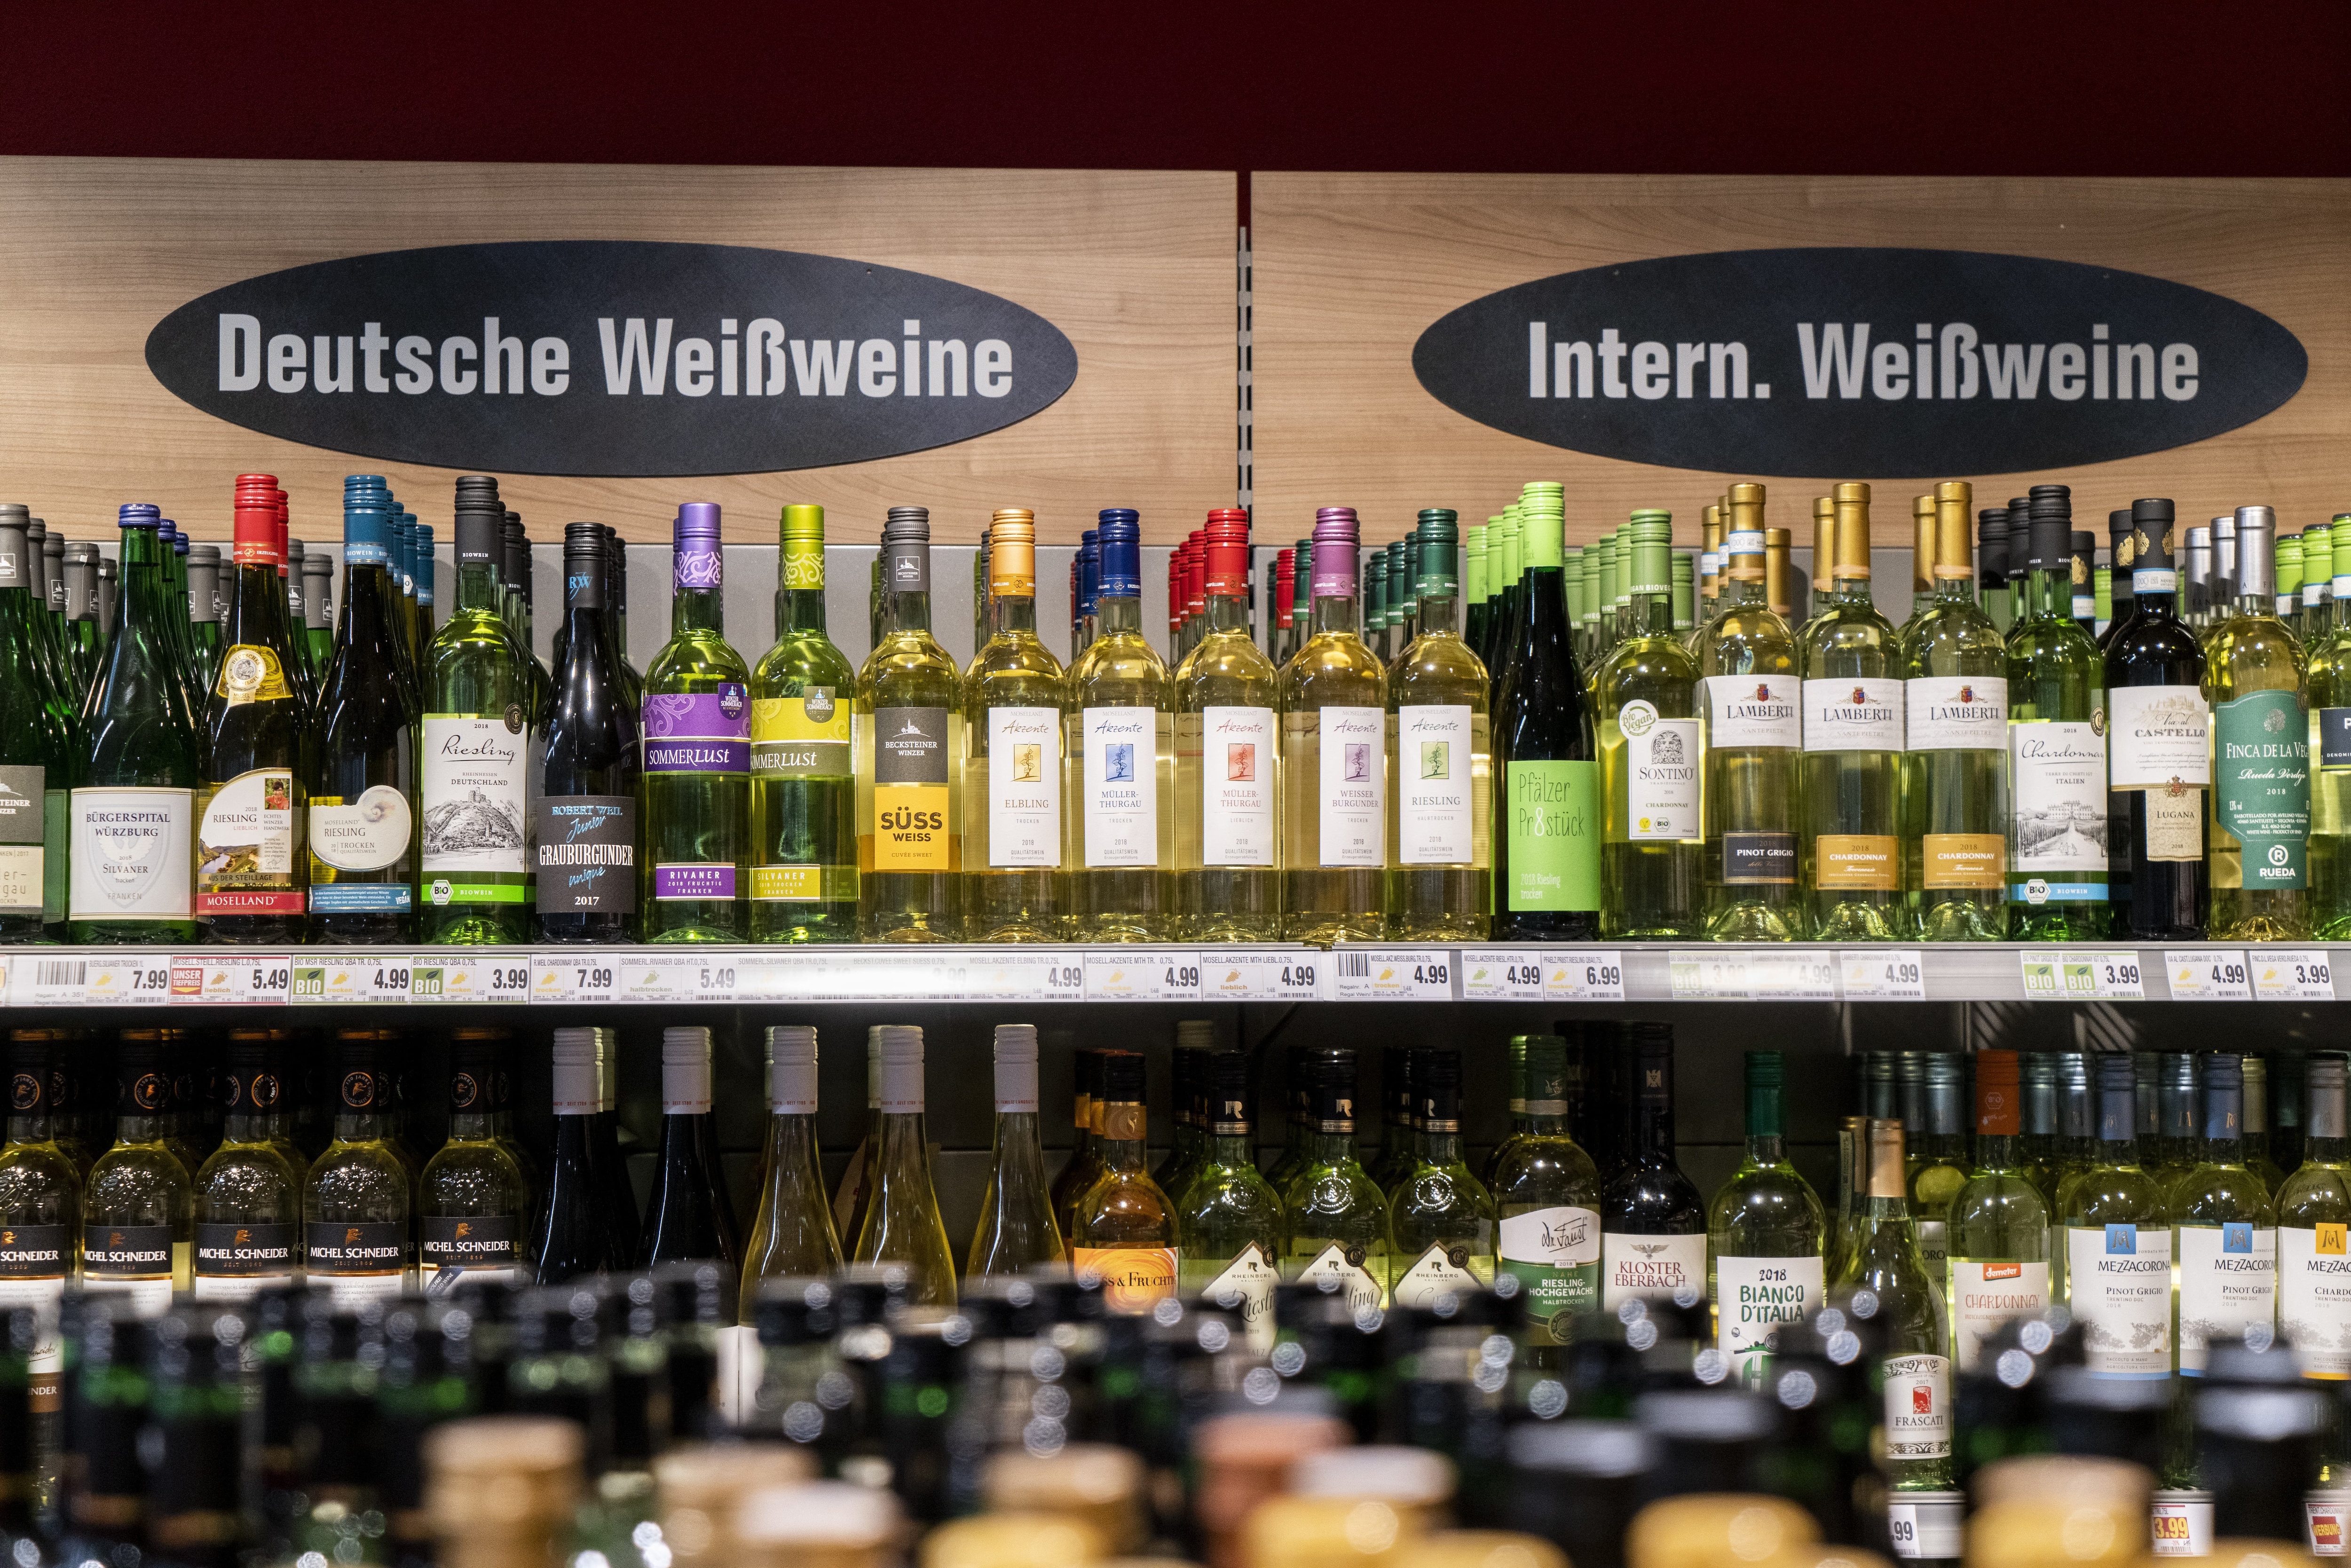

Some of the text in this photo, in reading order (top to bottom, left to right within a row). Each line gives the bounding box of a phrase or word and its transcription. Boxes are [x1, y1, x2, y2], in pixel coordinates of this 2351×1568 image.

[219, 313, 1014, 398] Deutsche Weißweine
[1529, 321, 2200, 402] Intern. Weißweine
[232, 654, 260, 665] DEUTSCHES
[1622, 711, 1636, 723] Bio
[1823, 708, 1892, 721] LAMBERTI
[2155, 713, 2188, 726] Via al
[1002, 719, 1050, 734] Akzente
[1411, 717, 1459, 732] Akzente
[1625, 713, 1656, 731] Vegan
[2135, 729, 2205, 737] CASTELLO
[441, 735, 516, 765] Riesling
[2022, 740, 2104, 767] Chardonnay
[2226, 742, 2291, 758] FINCA DE LA
[1640, 767, 1693, 780] SONTINO
[2238, 768, 2306, 787] Rueda Verdejo
[1101, 790, 1139, 798] MÜLLER-
[1519, 772, 1570, 803] Pfälzer
[1005, 799, 1049, 808] ELBLING
[1412, 796, 1460, 805] RIESLING
[552, 806, 623, 815] ROBERT WEIL
[87, 812, 170, 823] BÜRGERSPITAL
[213, 814, 257, 823] RIESLING
[881, 807, 943, 830] SÜSS
[1519, 807, 1585, 837] Pr8stück
[95, 827, 158, 836] WÜRZBURG
[324, 828, 365, 836] RIESLING
[566, 816, 607, 843] Junior
[892, 833, 931, 842] WEISS
[540, 844, 633, 866] GRAUBURGUNDER
[103, 863, 149, 874] SILVANER
[670, 871, 720, 879] RIVANER
[2260, 868, 2296, 877] RUEDA
[569, 866, 606, 890] unique
[1521, 874, 1561, 888] 2018 Riesling
[395, 895, 410, 905] VEGAN
[1521, 889, 1543, 899] trocken
[207, 896, 274, 906] MOSELLAND
[575, 897, 600, 906] 2017
[367, 958, 382, 967] 0,75L
[133, 970, 167, 989] 7.99
[173, 970, 201, 979] UNSER
[252, 969, 288, 989] 5.49
[374, 969, 409, 989] 4.99
[493, 969, 528, 989] 3.99
[1049, 967, 1081, 987] 4.99
[1586, 966, 1620, 985] 6.99
[2106, 965, 2139, 985] 3.99
[1542, 1217, 1586, 1248] Dr. Faust
[310, 1246, 399, 1258] MICHEL SCHNEIDER
[1620, 1261, 1682, 1275] KLOSTER
[1986, 1267, 2018, 1279] demeter
[1542, 1278, 1586, 1288] RIESLING-
[1615, 1274, 1686, 1288] EBERBACH
[1529, 1285, 1593, 1296] HOCHGEWÄCHS
[1740, 1285, 1804, 1303] BIANCO
[1895, 1416, 1943, 1426] FRASCATI
[2154, 1517, 2188, 1538] 3.99
[2311, 1523, 2341, 1536] WERBUNG
